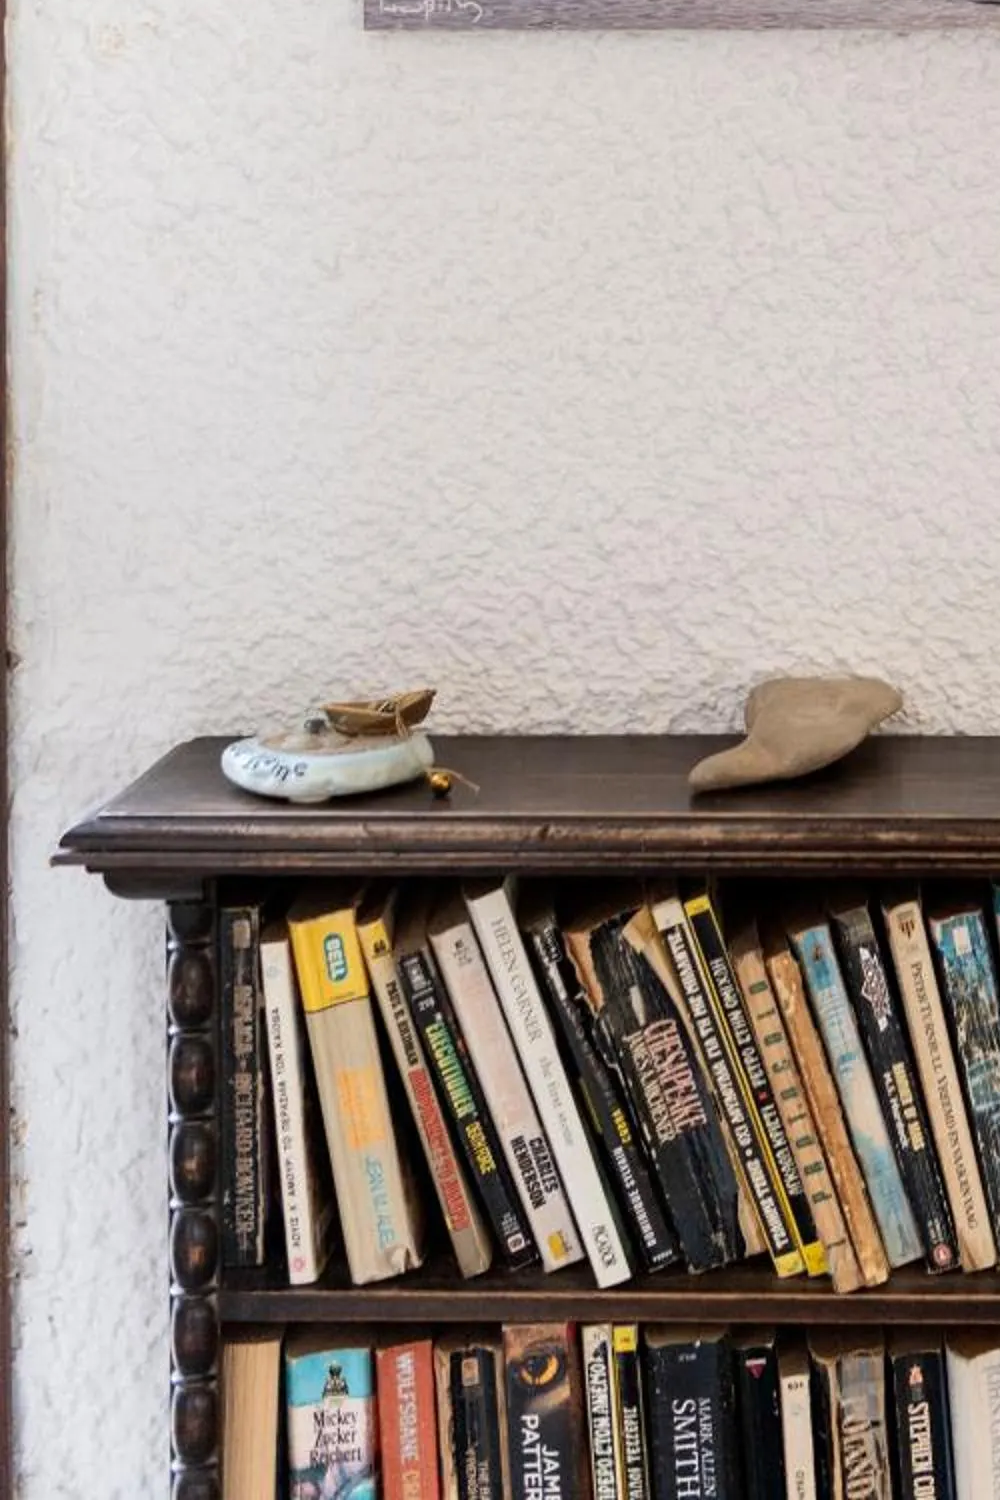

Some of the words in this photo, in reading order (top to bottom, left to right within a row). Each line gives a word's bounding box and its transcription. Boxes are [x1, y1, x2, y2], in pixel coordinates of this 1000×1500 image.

[323, 936, 347, 979] BELL
[910, 960, 930, 1003] PETER
[701, 1034, 722, 1059] ΓΙΑ
[488, 915, 522, 976] HELEN
[507, 971, 545, 1044] GARNER
[590, 1221, 618, 1269] PICADOR
[645, 1016, 708, 1134] CHESAPEAKE
[508, 1134, 547, 1211] HENDERSON
[526, 1135, 560, 1195] CHARLES
[314, 1408, 358, 1433] Mickey
[394, 1351, 419, 1464] WOLFSBANE
[697, 1396, 713, 1444] MARK
[315, 1427, 356, 1449] Zucker
[671, 1398, 701, 1500] SMITH
[906, 1400, 934, 1474] STEPHEN
[699, 1446, 716, 1497] ALLEN
